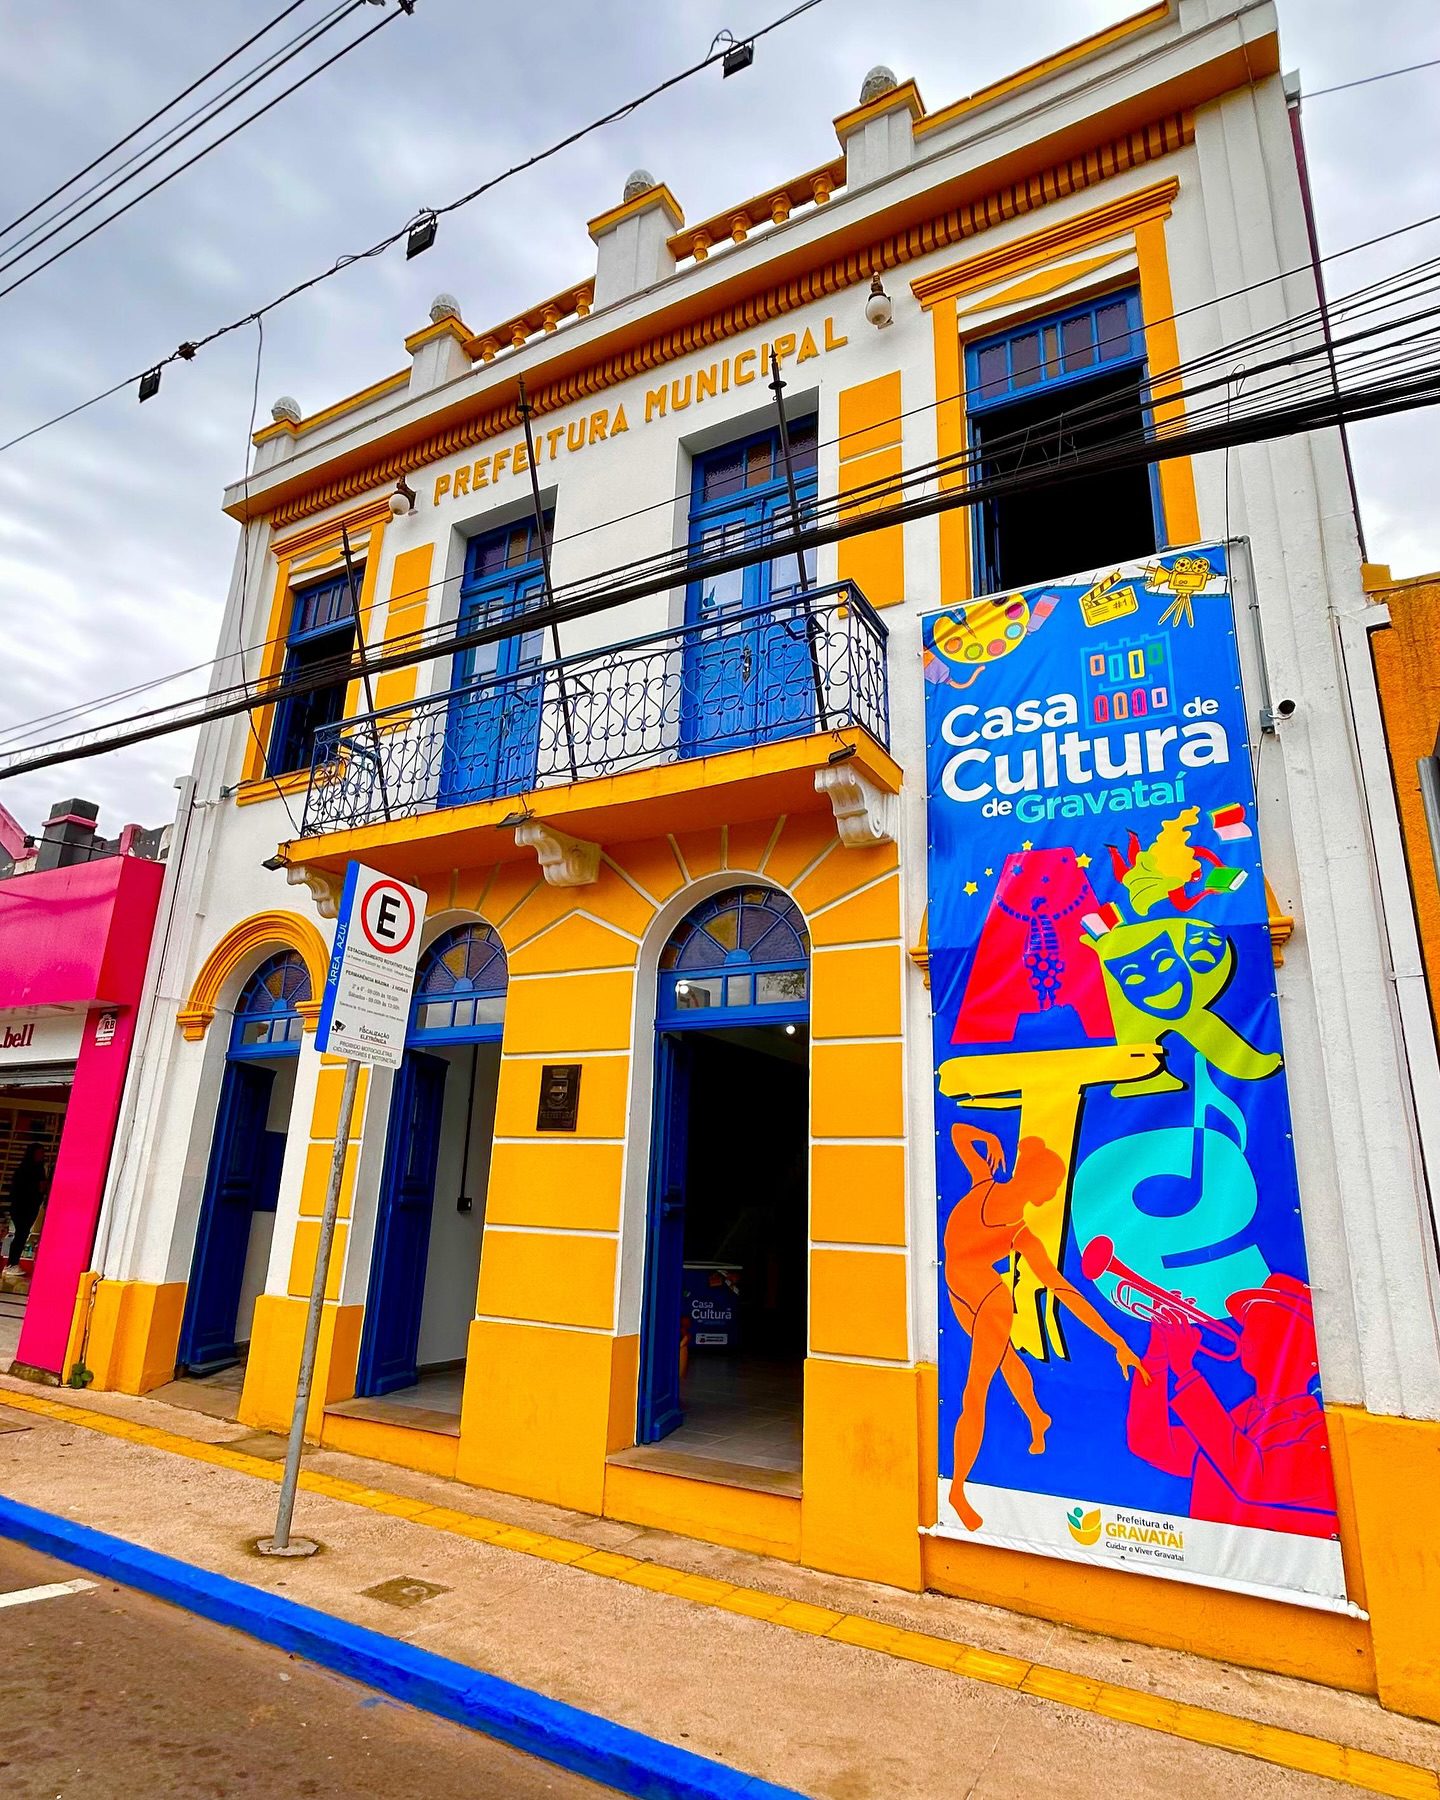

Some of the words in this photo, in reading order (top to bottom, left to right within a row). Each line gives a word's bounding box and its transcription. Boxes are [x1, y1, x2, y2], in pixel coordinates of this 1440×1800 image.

[433, 403, 629, 506] PREFEITURA
[644, 317, 849, 423] MUNICIPAL
[941, 693, 1078, 746] Casa
[1182, 697, 1219, 719] de
[941, 721, 1230, 803] Cultura
[981, 798, 1012, 819] de
[1015, 771, 1186, 823] Gravataí
[376, 893, 401, 939] E
[328, 956, 341, 986] ÁREA
[336, 922, 348, 949] AZUL
[691, 1299, 714, 1308] Casa
[691, 1308, 732, 1319] Cultura
[1105, 1522, 1184, 1549] GRAVATAÍ
[1116, 1513, 1160, 1528] Prefeitura
[1163, 1521, 1174, 1530] de
[1105, 1541, 1127, 1551] Cuidar
[1135, 1547, 1152, 1556] Viver
